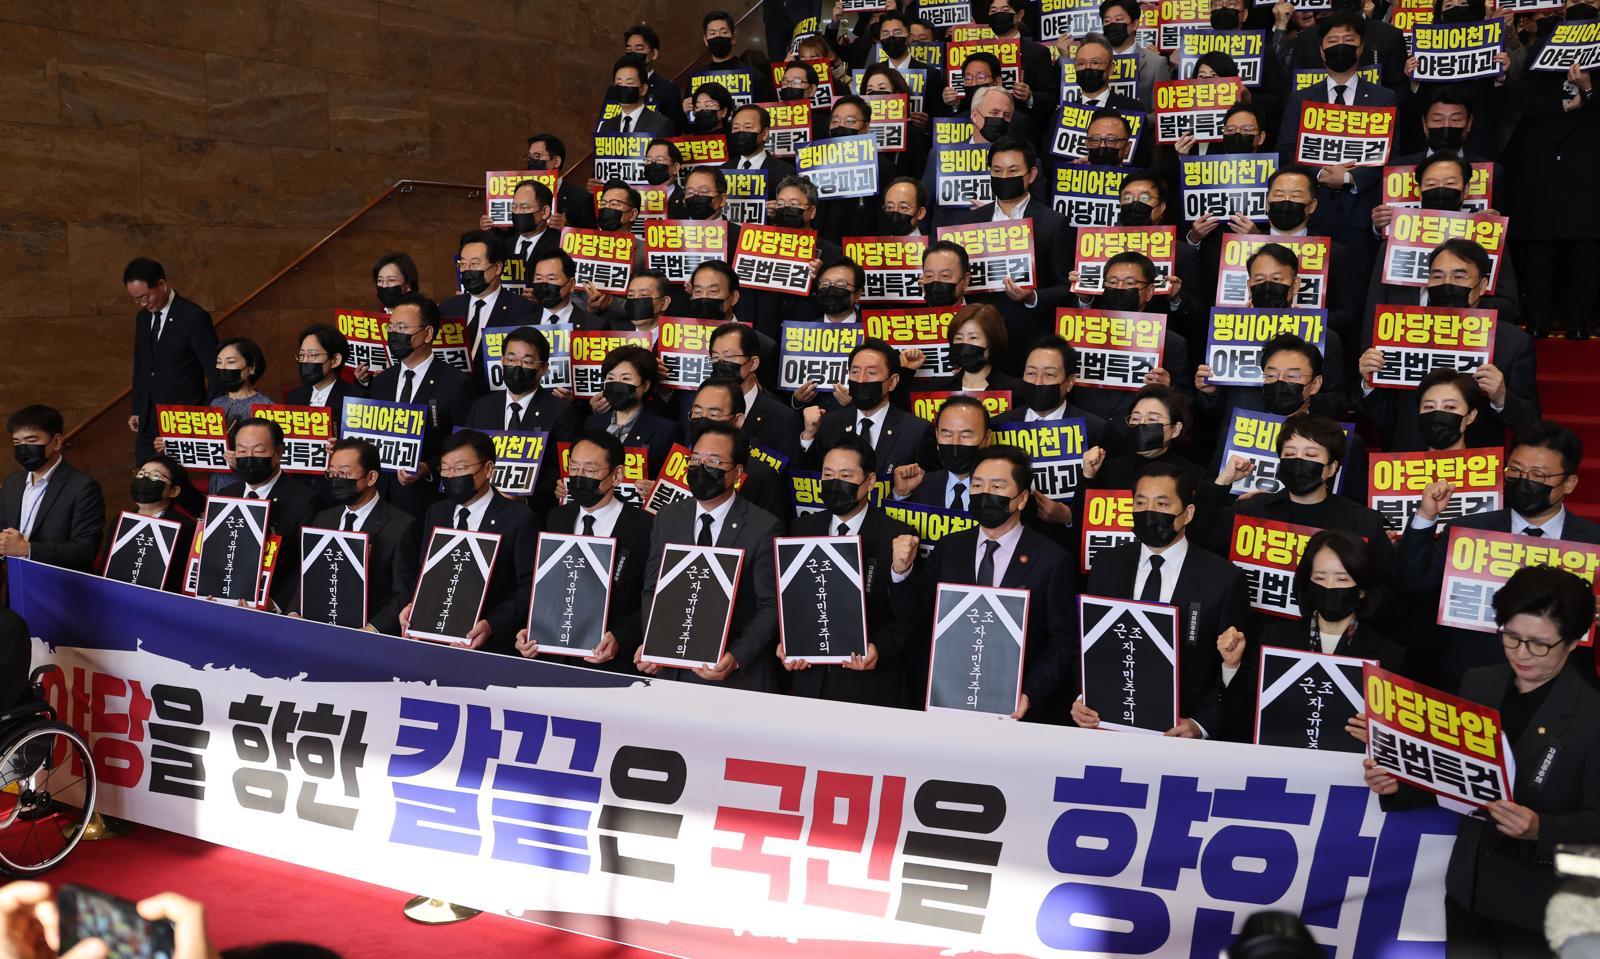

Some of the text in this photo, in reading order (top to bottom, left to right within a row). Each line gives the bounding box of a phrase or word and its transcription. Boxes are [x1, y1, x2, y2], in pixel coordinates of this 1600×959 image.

[1184, 35, 1262, 57] 명비어천가
[1415, 23, 1502, 50] 명비어천가
[1551, 22, 1600, 44] 명비어
[870, 99, 904, 120] 탄압
[1158, 83, 1237, 109] 야당탄압
[769, 104, 809, 127] 탄압
[1304, 108, 1392, 135] 야당탄압
[676, 139, 725, 163] 당탄압
[797, 140, 875, 169] 명비어천가
[939, 149, 991, 173] 명비어
[1301, 136, 1385, 162] 불법특검
[726, 174, 766, 197] 어천가
[811, 168, 875, 194] 당파괴
[1057, 168, 1127, 196] 명비어천
[1184, 160, 1276, 186] 명비어천가
[942, 175, 991, 201] 야당파
[729, 201, 763, 224] 파괴
[1056, 199, 1121, 227] 야당파
[647, 226, 725, 249] 야당탄압
[741, 229, 815, 260] 야당탄압
[1394, 215, 1503, 250] 야당탄압
[563, 233, 633, 260] 야당탄압
[846, 242, 925, 267] 야당탄압
[575, 262, 630, 289] 법특검
[650, 254, 722, 278] 불법특
[737, 257, 810, 290] 불법특검
[969, 258, 1029, 287] 법특검
[862, 272, 924, 298] 법특검
[1223, 273, 1321, 304] 불검
[1060, 314, 1163, 349] 야당탄압
[1213, 313, 1323, 344] 명비어천가
[1378, 312, 1493, 347] 야당탄압
[663, 354, 714, 382] 불법
[785, 359, 850, 385] 야당파
[1075, 350, 1157, 384] 법특검
[1212, 349, 1263, 379] 야당
[575, 368, 604, 393] 불법
[160, 410, 224, 436] 야당탄압
[346, 403, 424, 436] 명비어천가
[164, 440, 226, 467] 불법특검
[281, 441, 329, 468] 법특검
[491, 435, 545, 461] 어천가
[992, 425, 1084, 458] 비어천가
[493, 466, 534, 491] 파괴
[1033, 462, 1082, 495] 파괴
[1374, 455, 1500, 491] 야당탄압
[225, 516, 245, 528] 근조
[1088, 497, 1134, 527] 야당
[135, 533, 154, 547] 근조
[1235, 525, 1308, 566] 야당
[131, 547, 146, 584] 자유민
[222, 528, 239, 597] 자유민주주의
[324, 548, 344, 562] 근조
[450, 548, 471, 563] 근조
[563, 555, 586, 569] 근조
[806, 558, 833, 572] 근조
[686, 565, 710, 579] 근조
[435, 563, 463, 633] 자유민주주의
[559, 570, 578, 646] 자유민주주의
[675, 581, 702, 657] 자유민주주의
[814, 574, 830, 654] 자유민주주의
[966, 607, 994, 624] 근조
[1113, 623, 1143, 640] 근조
[966, 625, 987, 709] 자유민주주의
[1121, 640, 1137, 725] 자유민주주의
[1299, 677, 1334, 695] 근조
[1305, 696, 1324, 750] 자유민
[1367, 675, 1497, 758] 야당탄압
[1371, 725, 1502, 801] 불법특검
[42, 665, 210, 801] 야당을
[228, 694, 369, 831] 향한
[387, 696, 688, 884] 칼끝은
[710, 756, 1007, 934] 국민을
